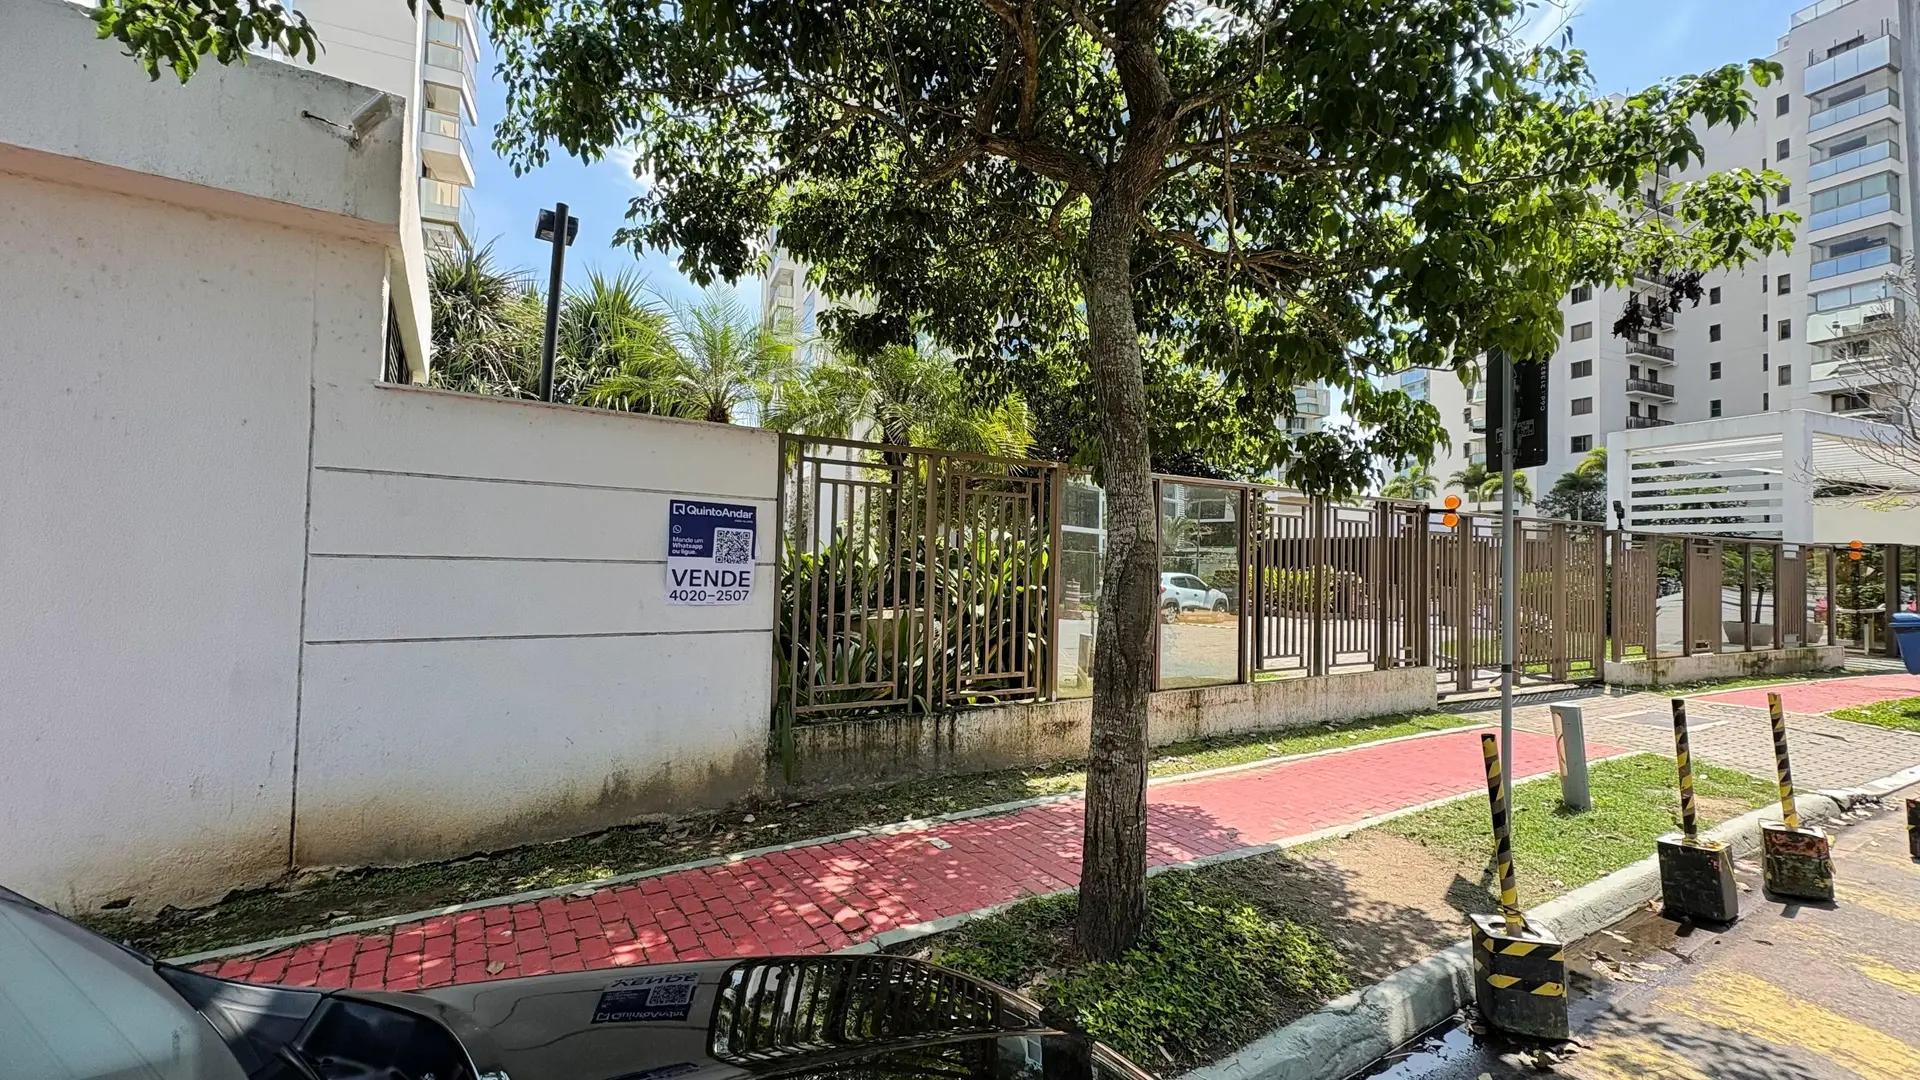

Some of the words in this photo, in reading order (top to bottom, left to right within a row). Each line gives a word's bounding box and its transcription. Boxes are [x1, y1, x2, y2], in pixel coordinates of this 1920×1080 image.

[687, 505, 753, 519] QuintoAndar
[672, 536, 693, 544] Mande
[672, 543, 703, 551] Whatsapp
[671, 569, 751, 588] VENDE
[669, 590, 750, 601] 4020-2507
